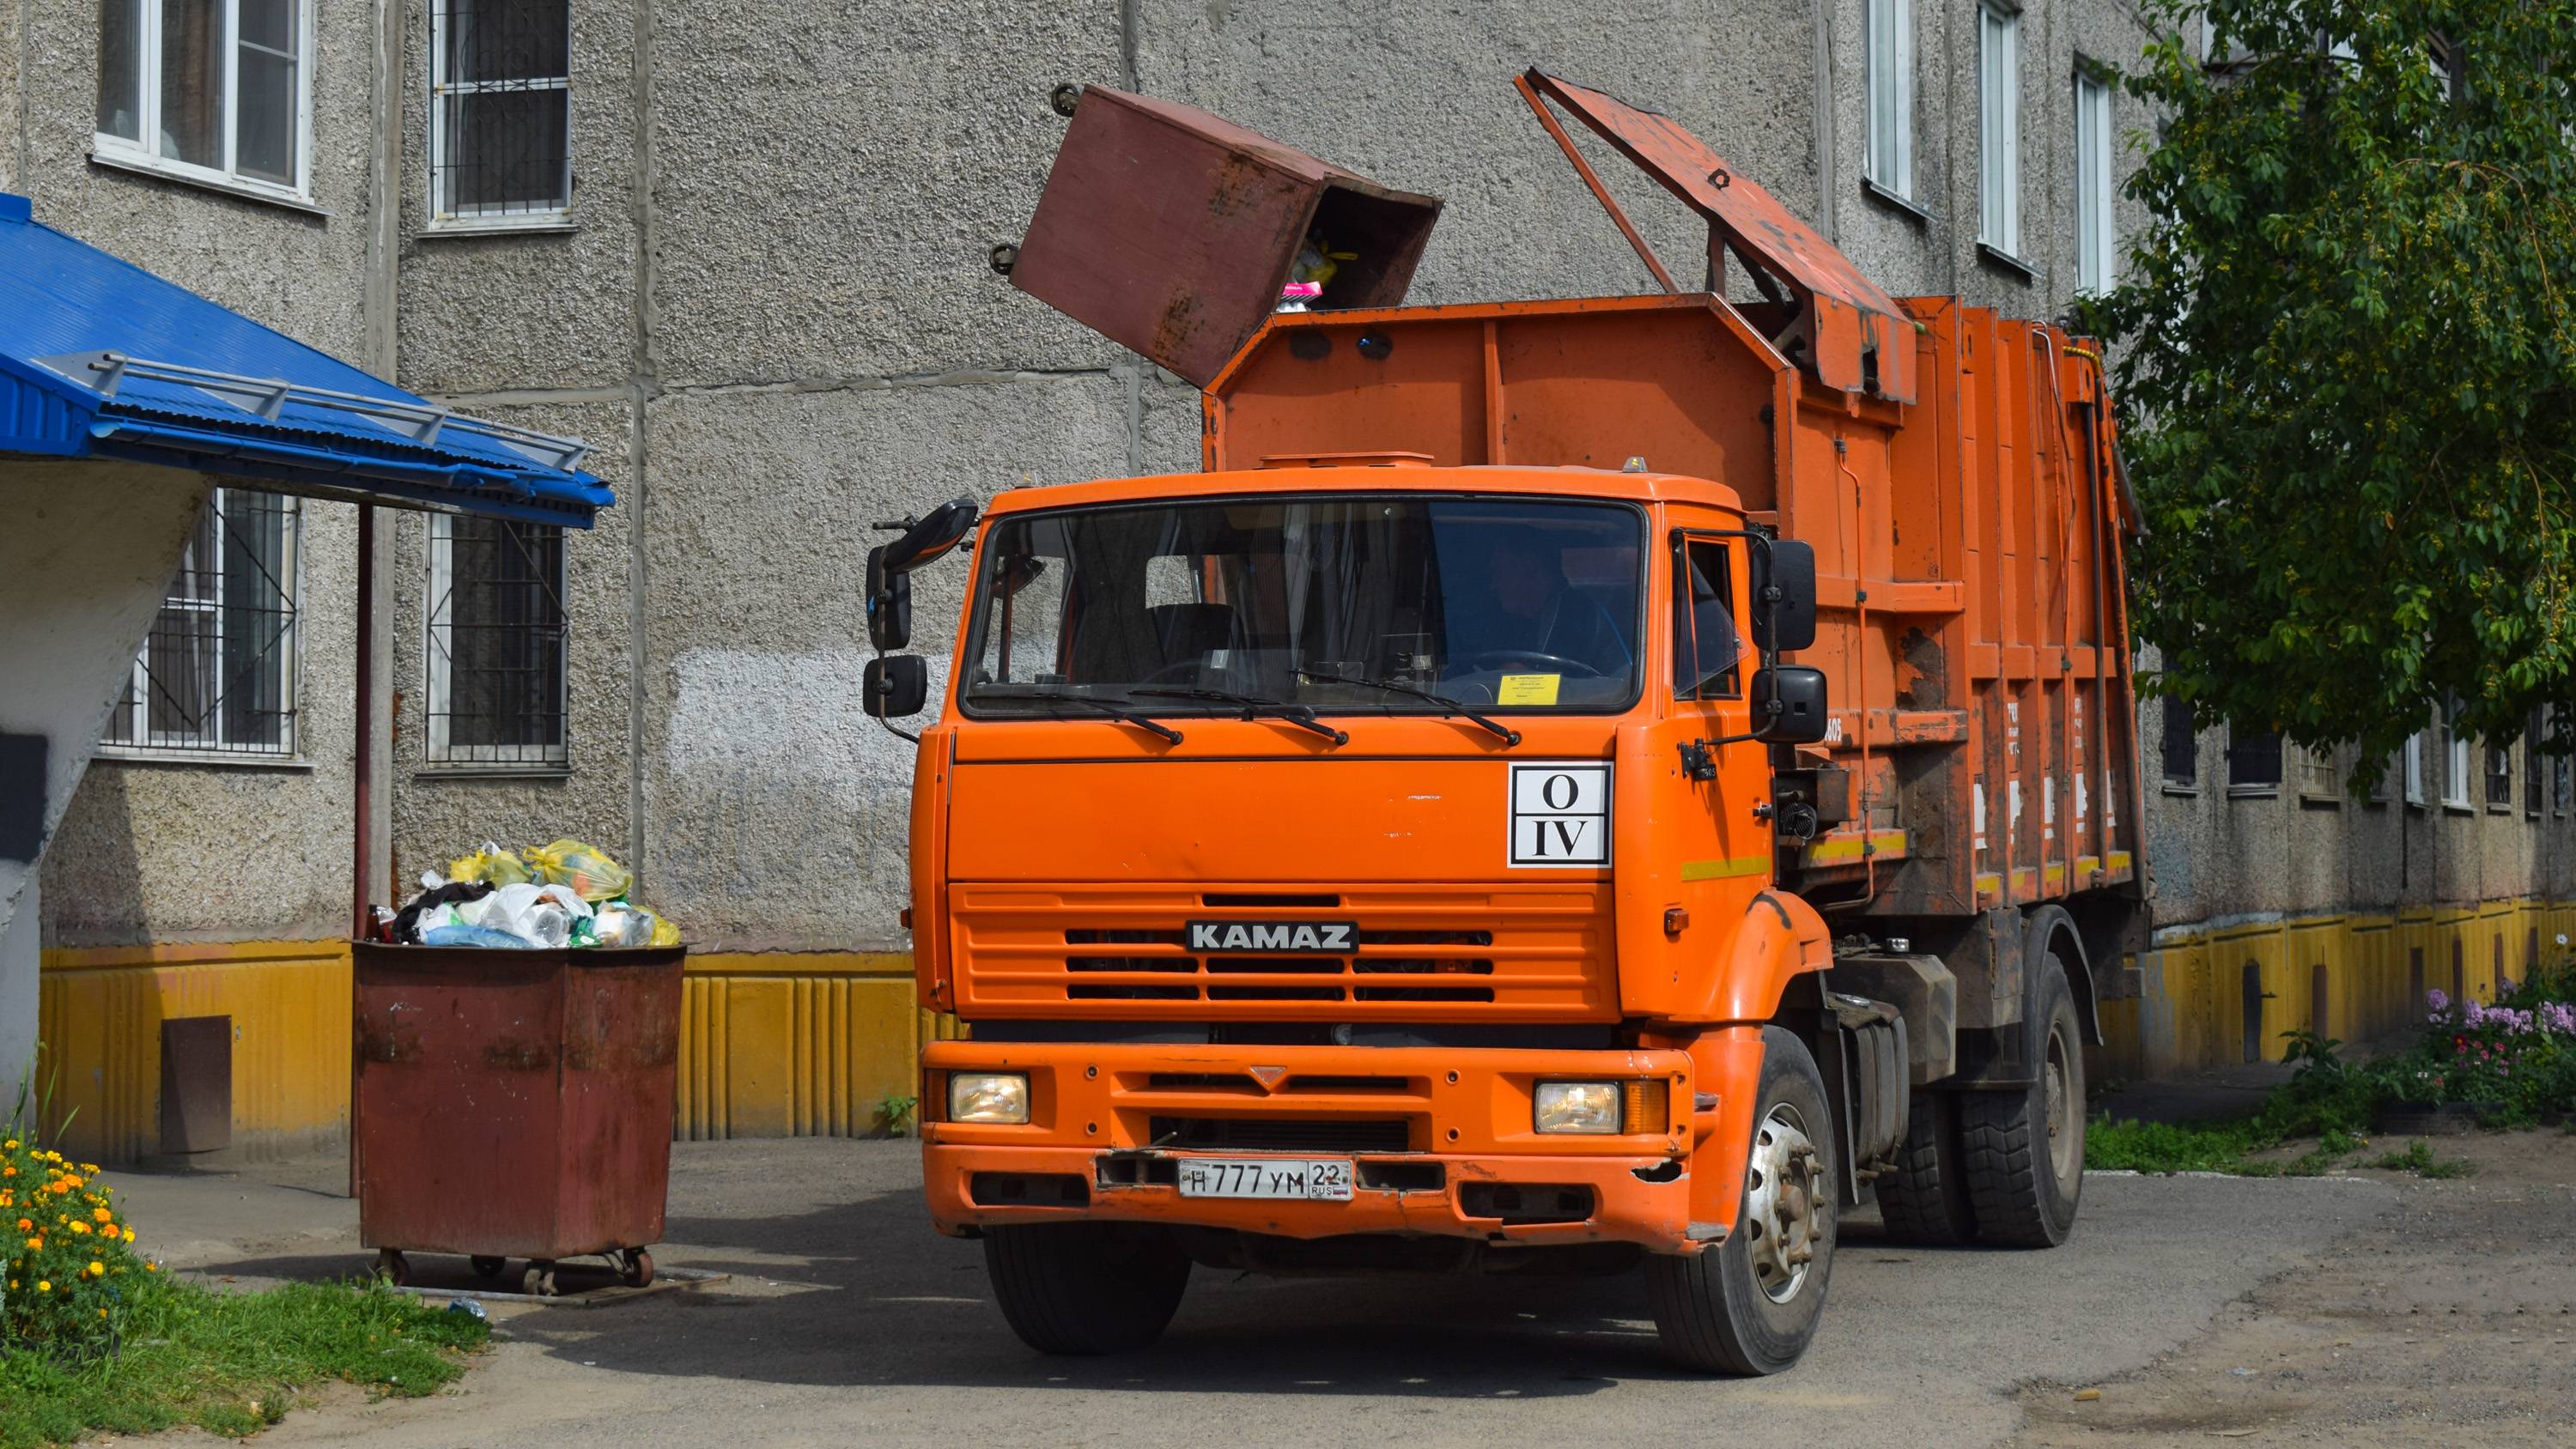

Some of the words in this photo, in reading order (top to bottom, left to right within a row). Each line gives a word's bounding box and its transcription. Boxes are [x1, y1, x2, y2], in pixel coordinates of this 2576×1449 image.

[1542, 774, 1579, 809] O
[1532, 820, 1589, 857] IV
[1193, 925, 1351, 949] KAMAZ
[1313, 1165, 1340, 1185] 22
[1311, 1186, 1333, 1196] RUS
